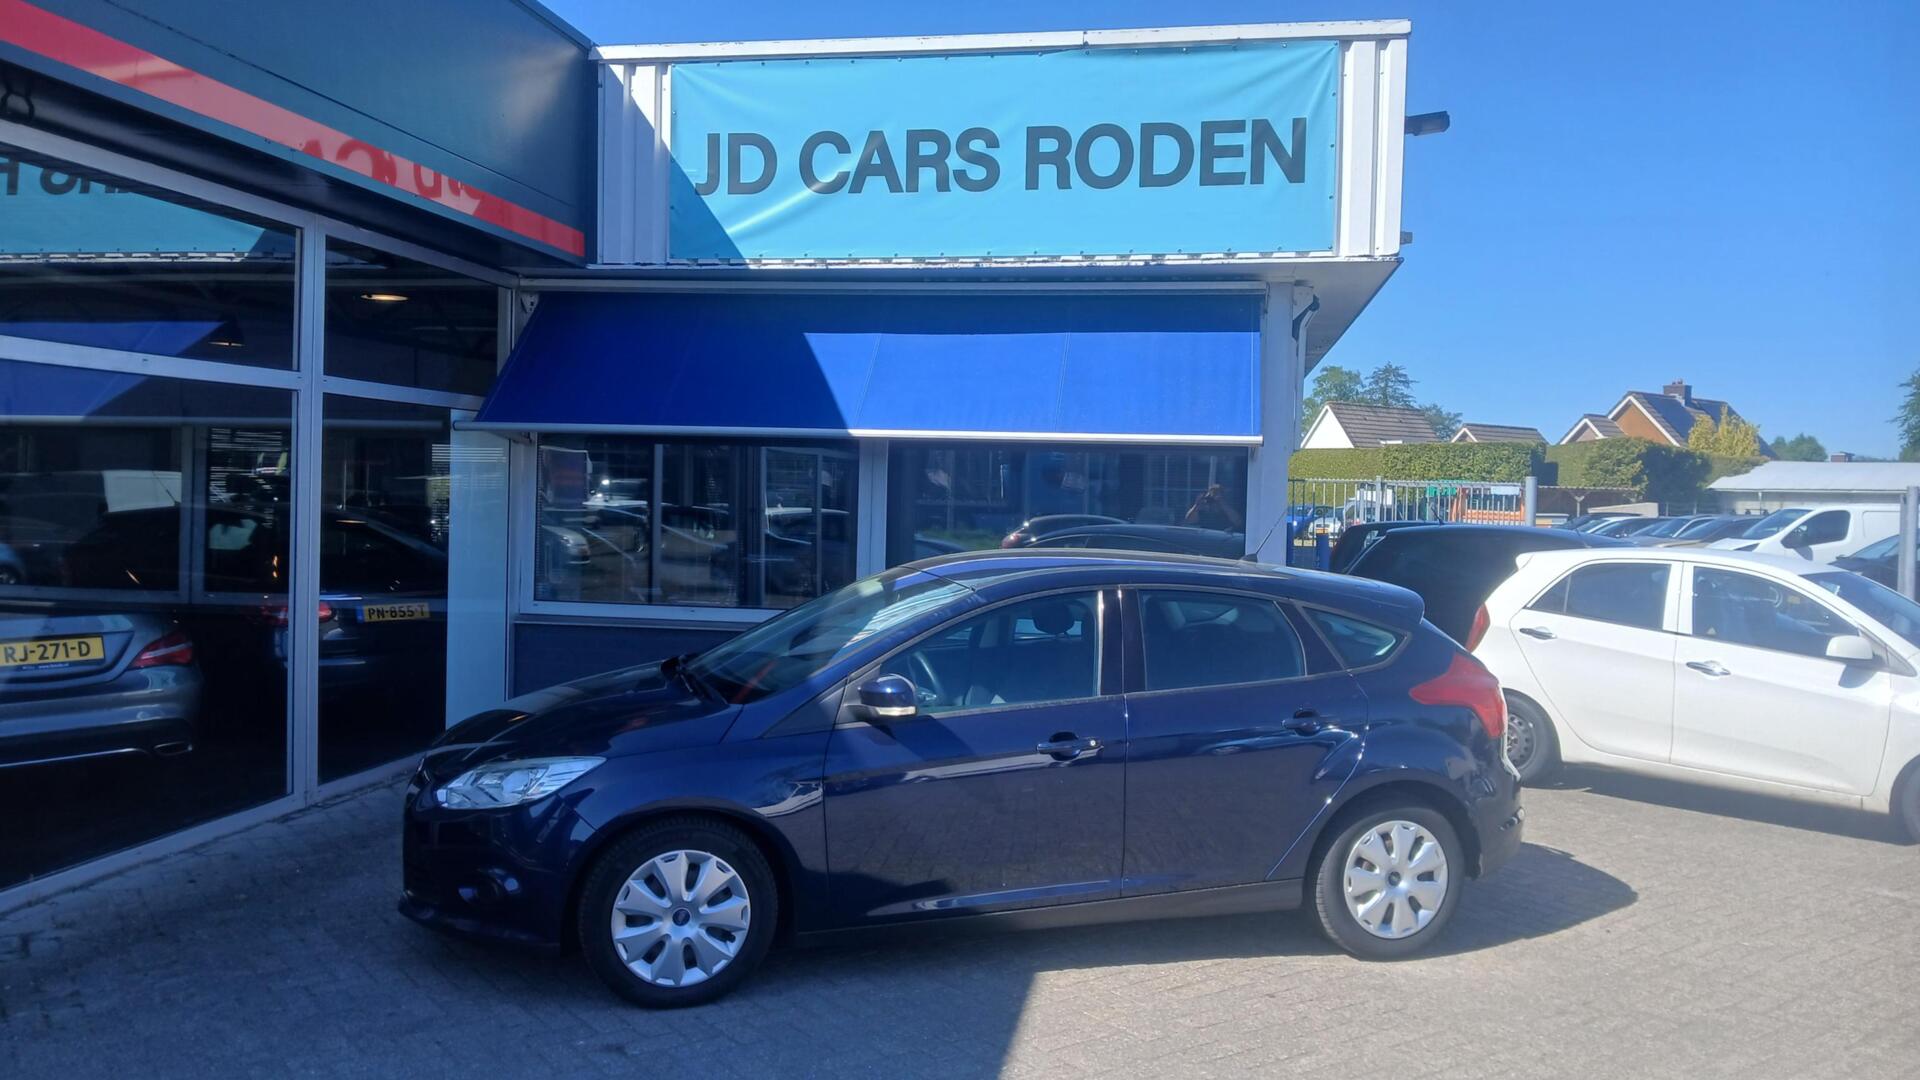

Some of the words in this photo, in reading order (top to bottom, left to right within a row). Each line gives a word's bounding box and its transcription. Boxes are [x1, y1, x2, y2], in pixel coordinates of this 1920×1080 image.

[694, 132, 777, 195] JD
[799, 127, 1000, 194] CARS
[1024, 118, 1307, 190] RODEN
[3, 641, 91, 662] RJ-271-D
